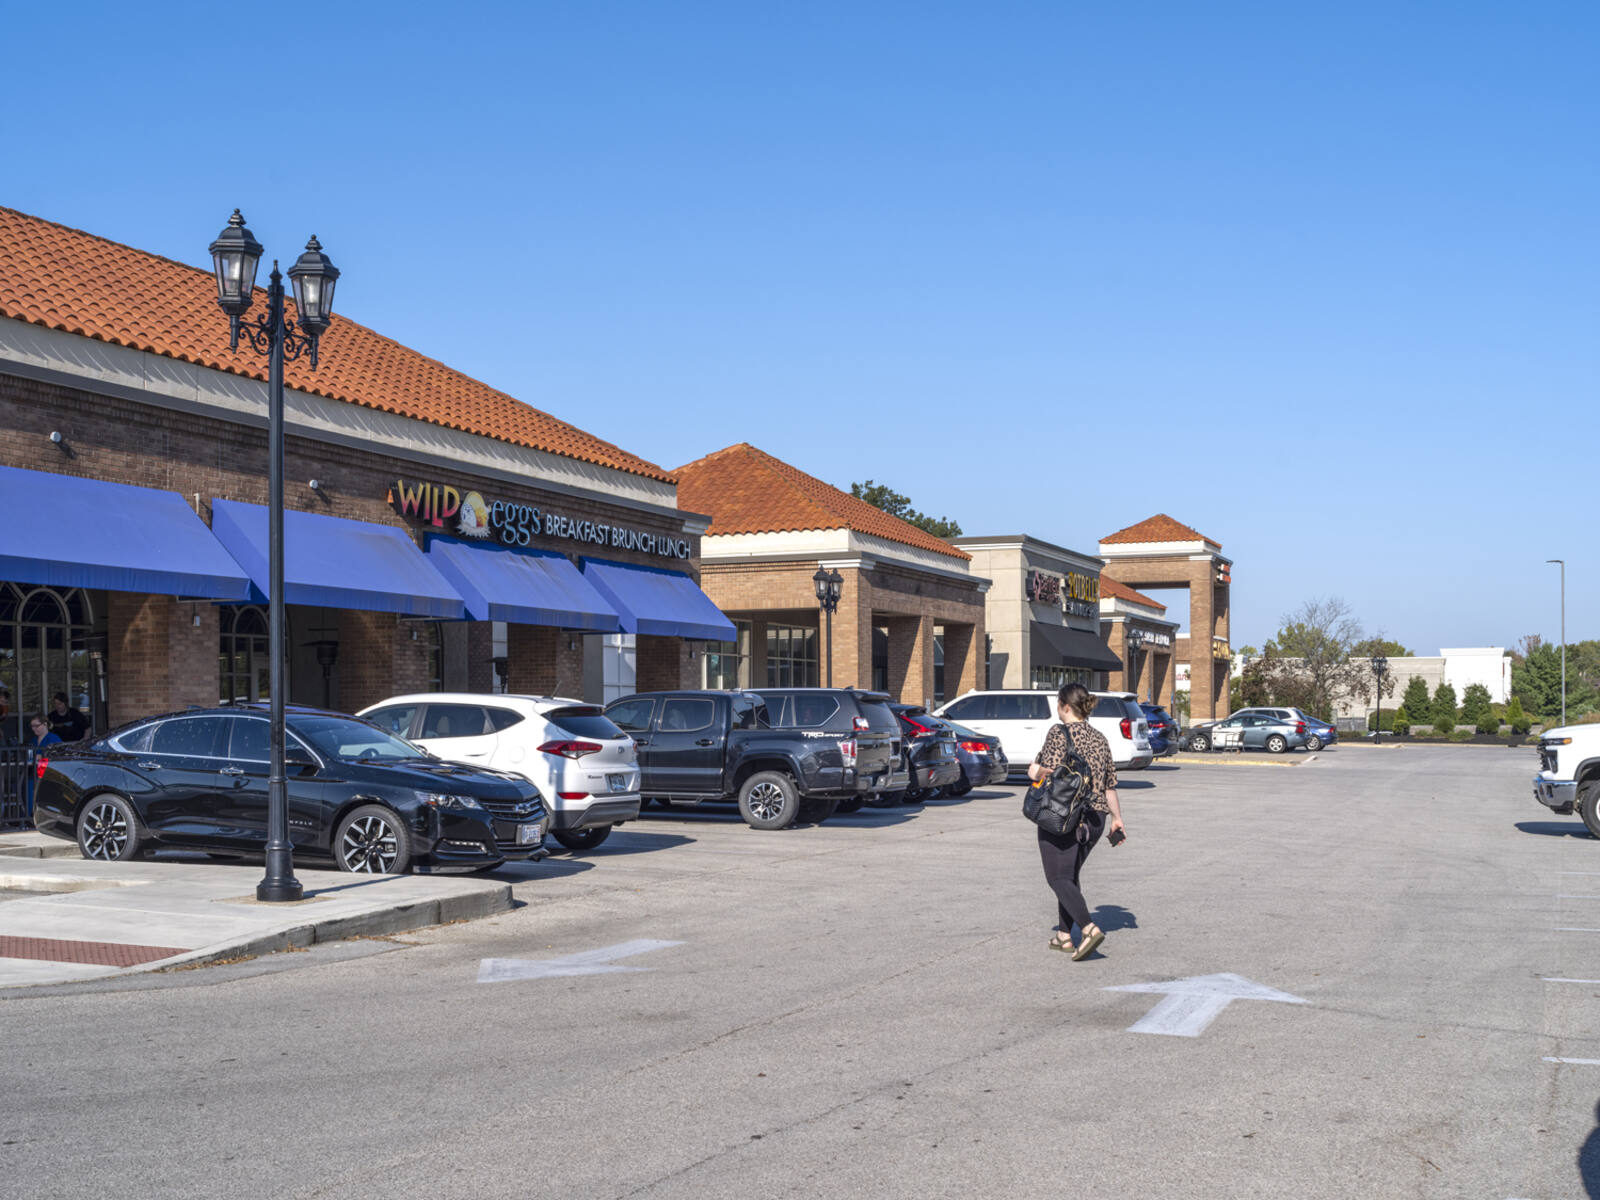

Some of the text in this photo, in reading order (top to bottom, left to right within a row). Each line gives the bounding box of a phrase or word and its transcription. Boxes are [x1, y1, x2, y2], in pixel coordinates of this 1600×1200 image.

[397, 479, 541, 546] WILD eggs
[546, 514, 692, 560] BREAKFAST BRUNCH LUNCH
[801, 731, 824, 739] TRD
